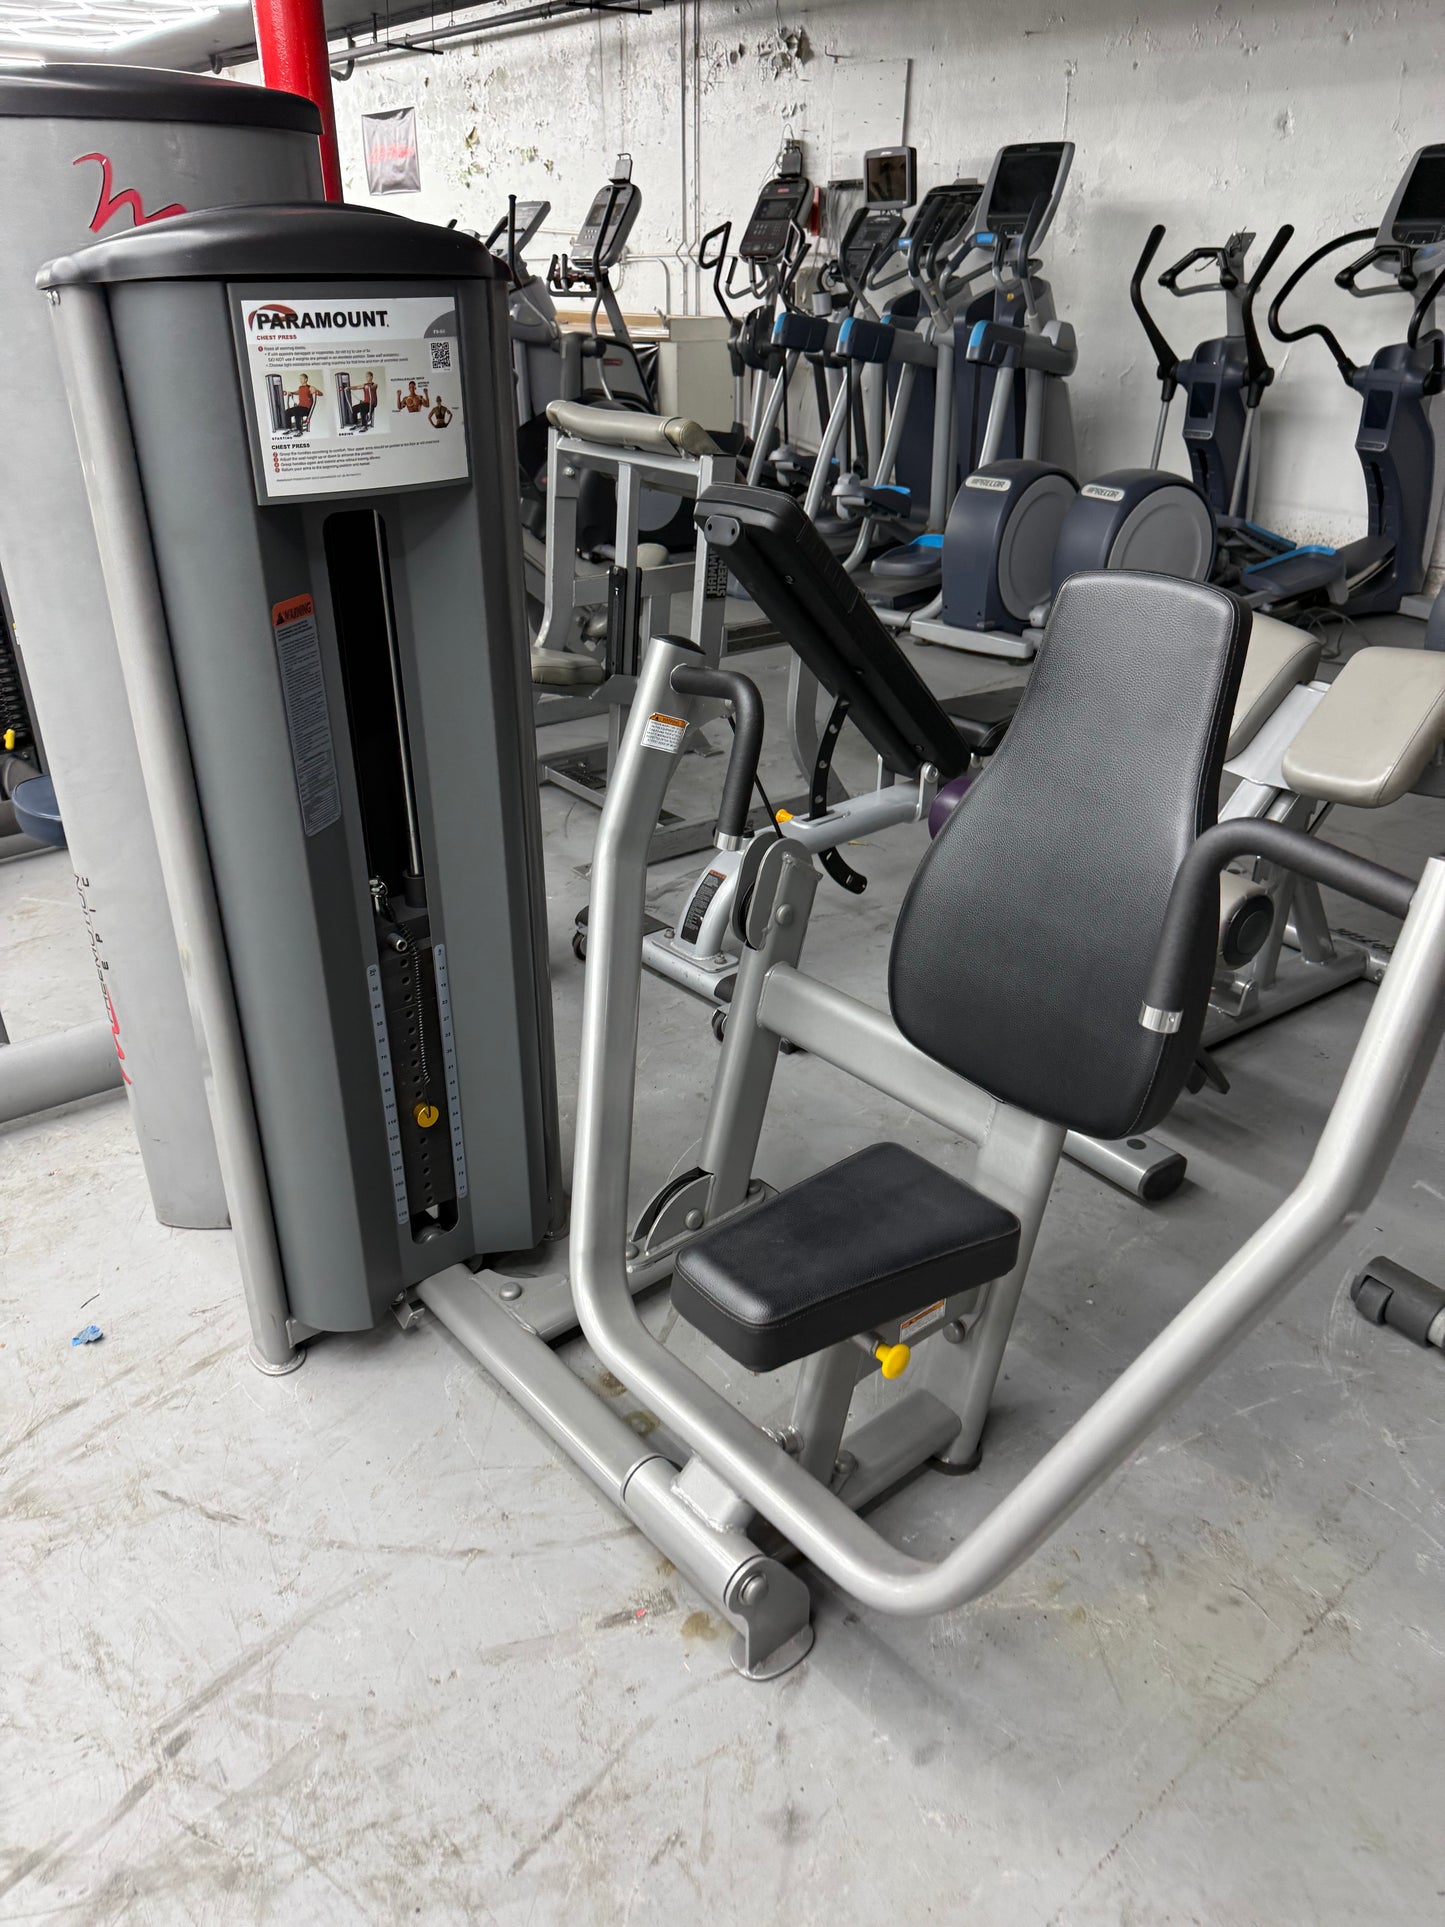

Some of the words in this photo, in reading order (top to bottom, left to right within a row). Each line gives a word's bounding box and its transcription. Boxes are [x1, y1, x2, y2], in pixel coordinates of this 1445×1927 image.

[256, 310, 388, 330] PARAMOUNT
[974, 479, 1006, 488] PRECOR
[707, 548, 719, 595] HAMM
[717, 560, 728, 597] STREN
